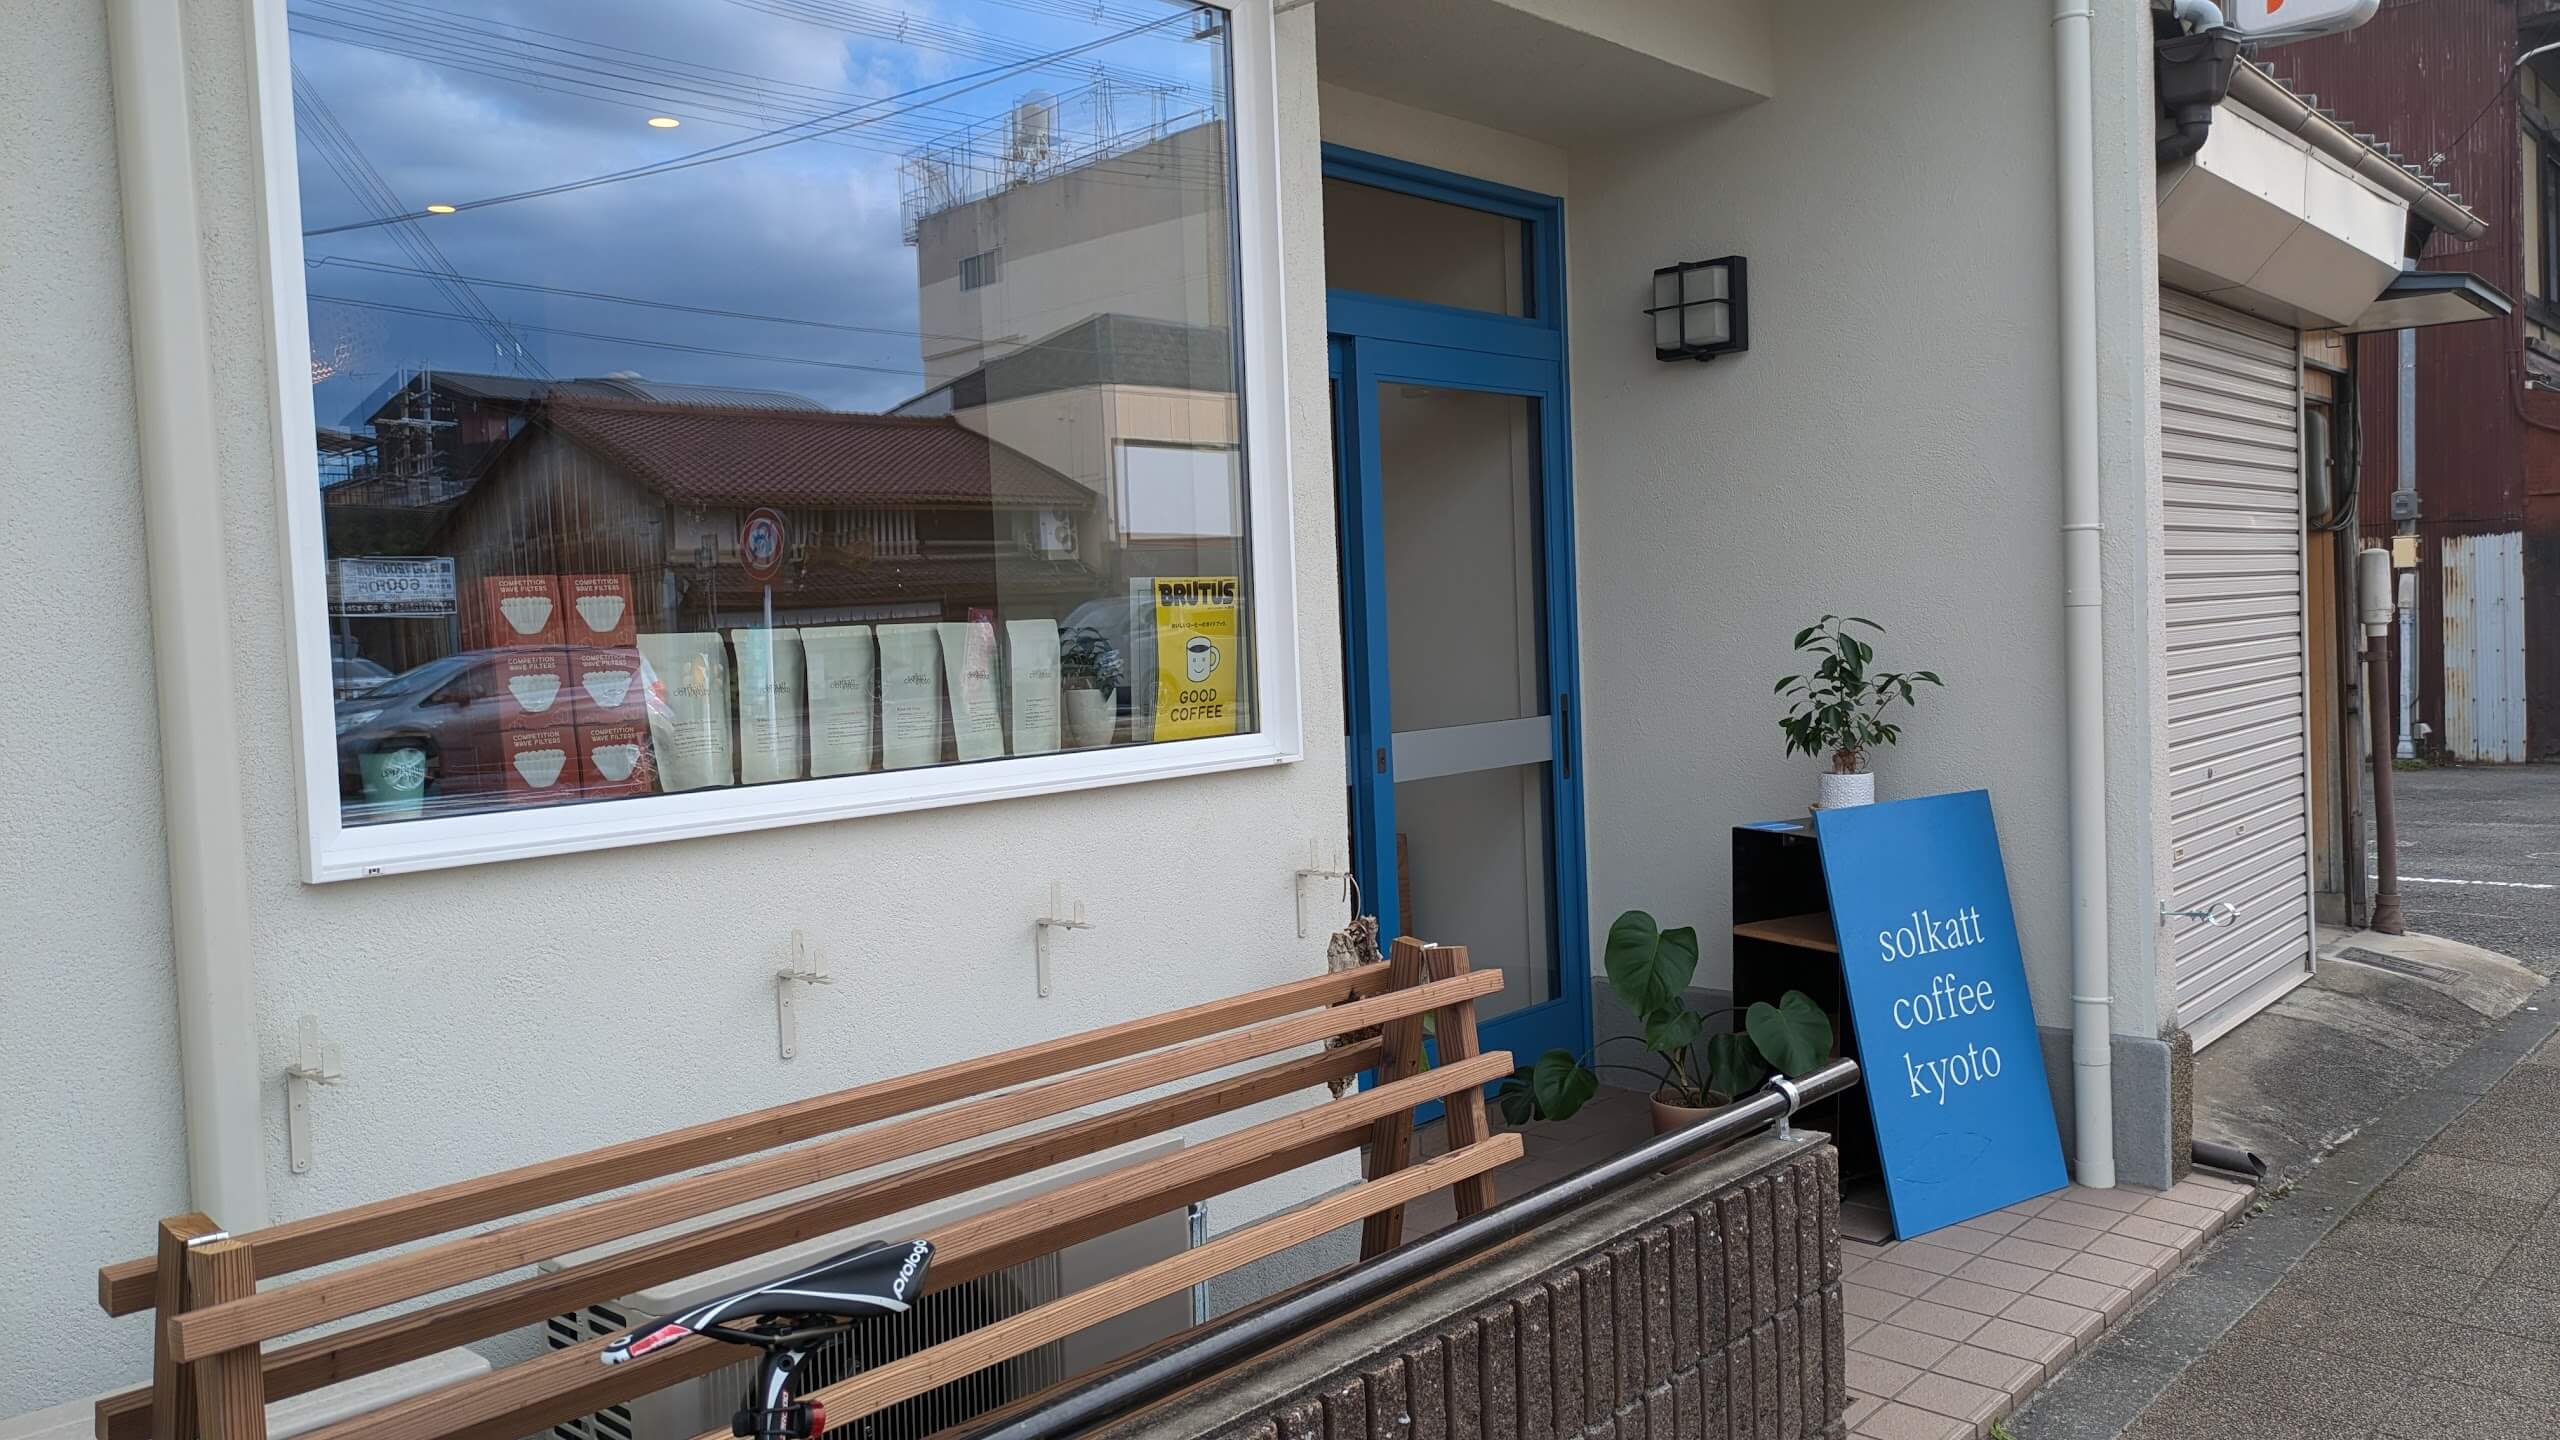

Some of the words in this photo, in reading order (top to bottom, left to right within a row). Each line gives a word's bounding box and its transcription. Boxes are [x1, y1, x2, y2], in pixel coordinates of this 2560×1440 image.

[499, 579, 546, 587] COMPETITION
[575, 578, 619, 586] COMPETITION
[500, 585, 519, 593] WAVE
[520, 584, 547, 593] FILTERS
[594, 584, 620, 592] FILTERS
[1158, 580, 1235, 607] BRUTUS
[508, 656, 555, 665] COMPETITION
[510, 663, 527, 671] WAVE
[528, 662, 556, 670] FILTERS
[1179, 688, 1217, 704] GOOD
[1170, 704, 1224, 722] COFFEE
[512, 731, 560, 742] COMPETITION
[590, 727, 634, 736] COMPETITION
[591, 734, 609, 742] WAVE
[610, 732, 636, 741] FILTERS
[513, 739, 532, 748] WAVE
[534, 737, 561, 746] FILTERS
[1879, 905, 1985, 962] solkatt
[1893, 973, 1996, 1030] coffee
[1903, 1042, 2001, 1106] kyoto
[893, 1239, 929, 1301] prologo
